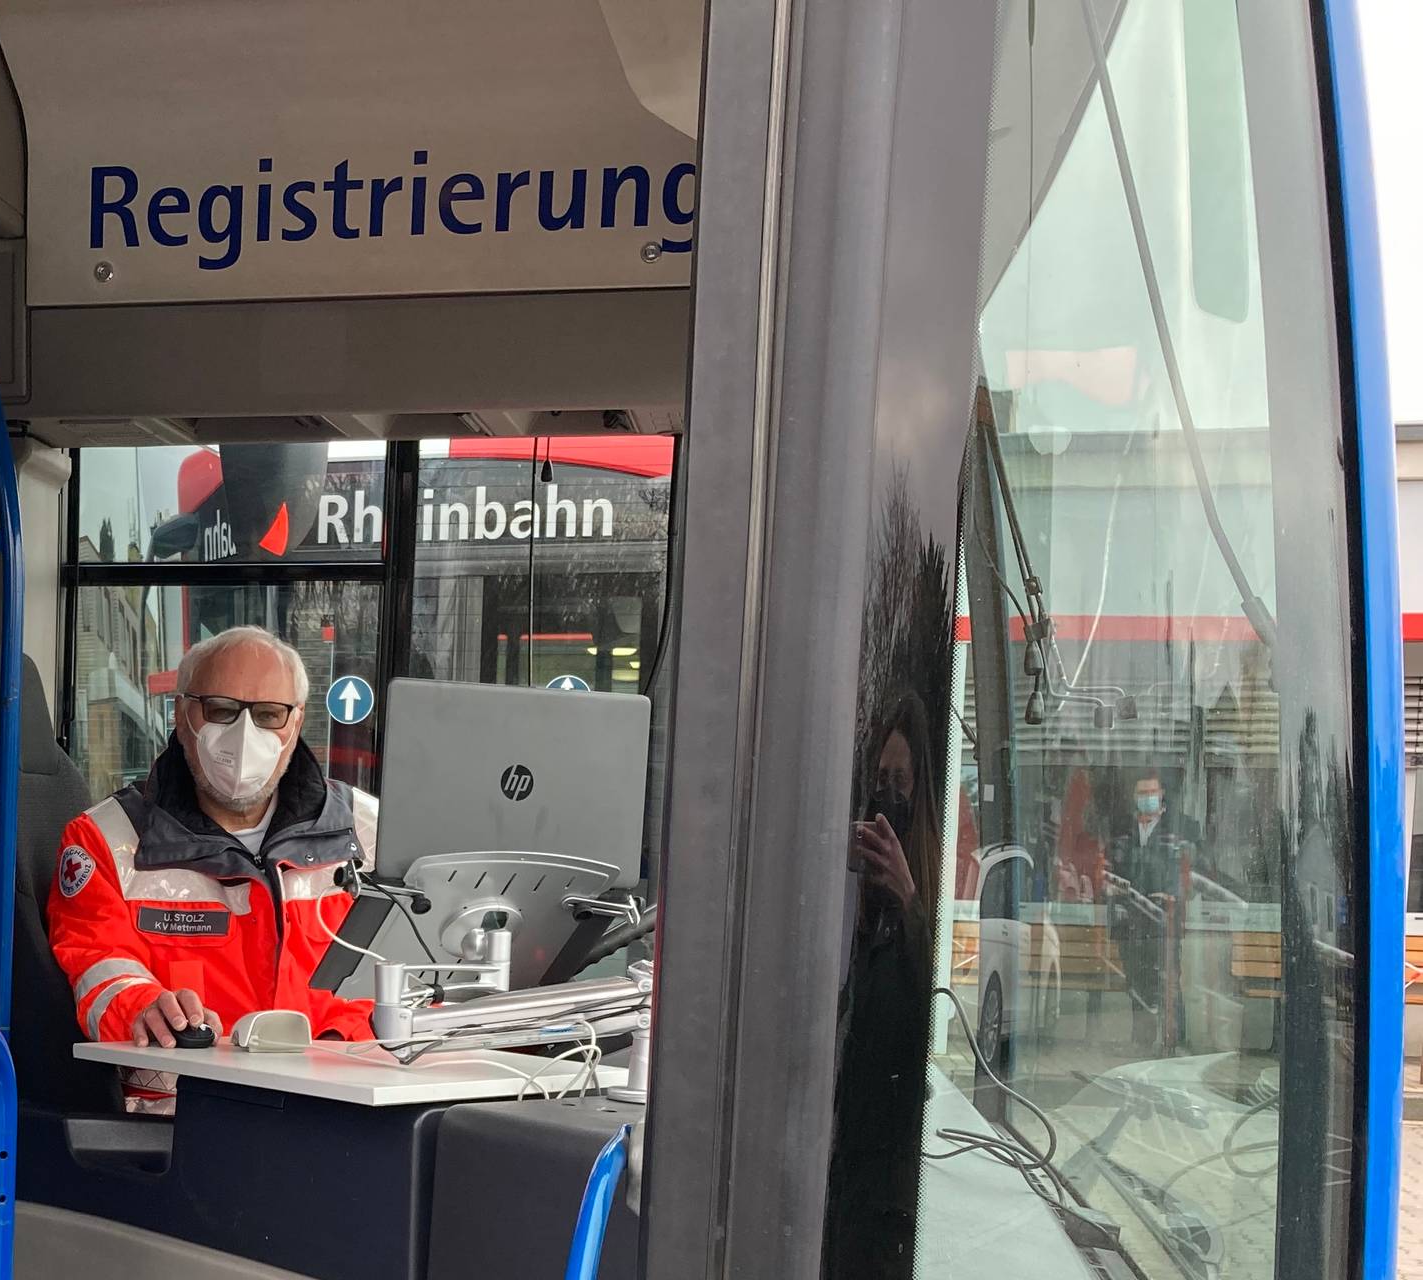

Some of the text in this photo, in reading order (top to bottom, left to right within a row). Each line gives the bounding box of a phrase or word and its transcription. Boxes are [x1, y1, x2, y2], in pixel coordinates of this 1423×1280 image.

[90, 150, 696, 270] Registrierung
[317, 484, 614, 545] Rhinbahn
[502, 765, 532, 800] hp
[169, 923, 212, 932] Mettmann
[174, 913, 205, 923] STOLZ
